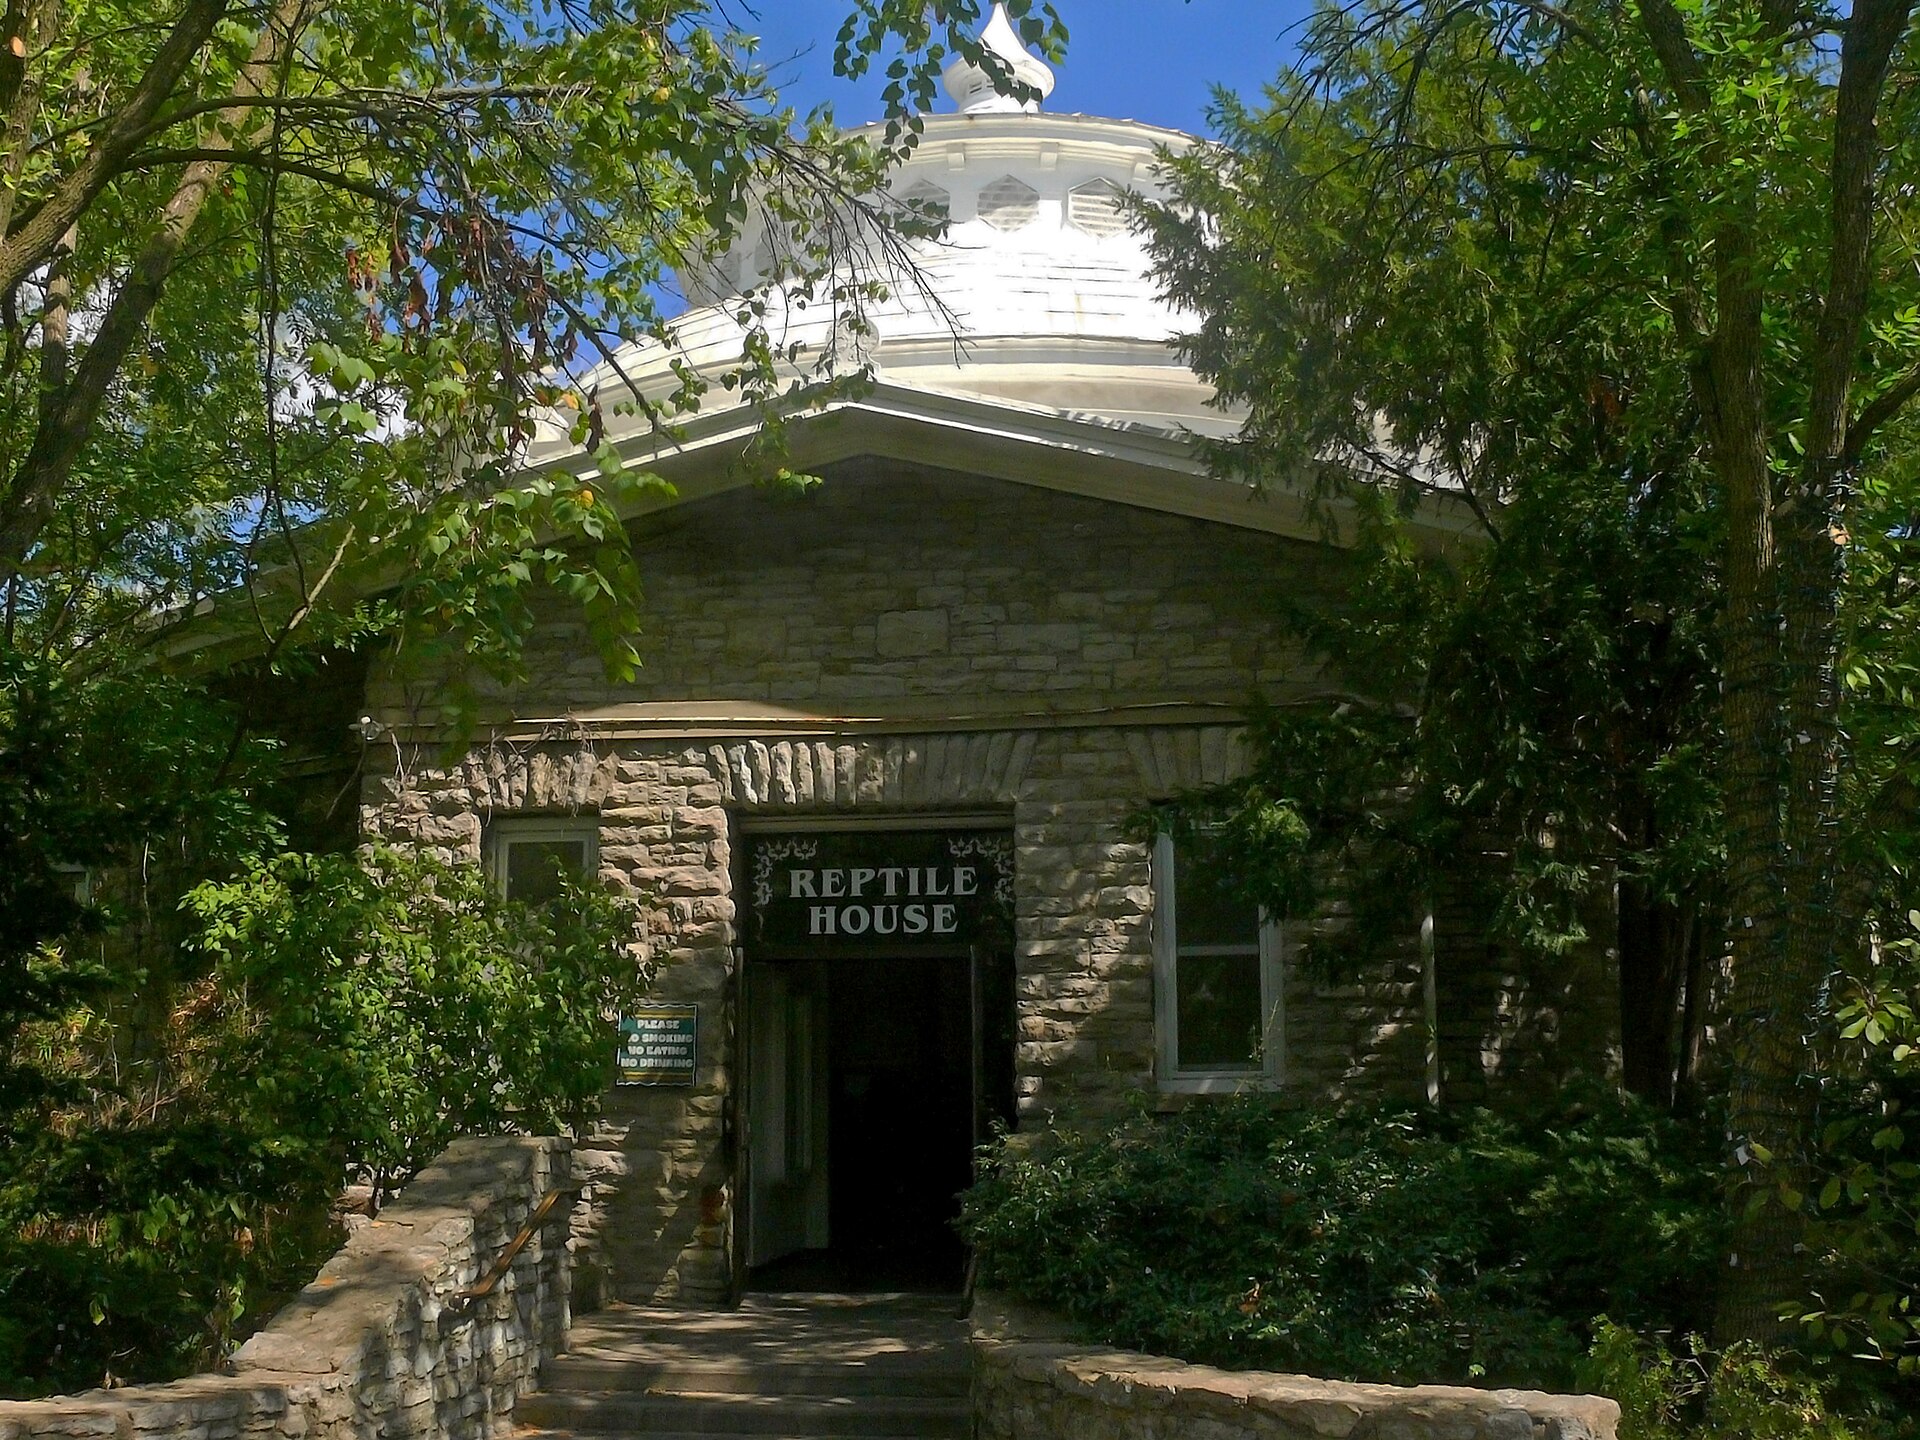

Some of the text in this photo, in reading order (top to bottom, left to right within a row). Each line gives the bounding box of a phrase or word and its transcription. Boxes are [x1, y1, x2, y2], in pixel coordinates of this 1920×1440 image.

[789, 867, 979, 898] REPTILE
[808, 904, 959, 935] HOUSE
[637, 1019, 680, 1029] PLEASE
[641, 1033, 694, 1043] SMOKING
[627, 1045, 688, 1055] NO EATING
[620, 1057, 694, 1068] NO DRINKING
